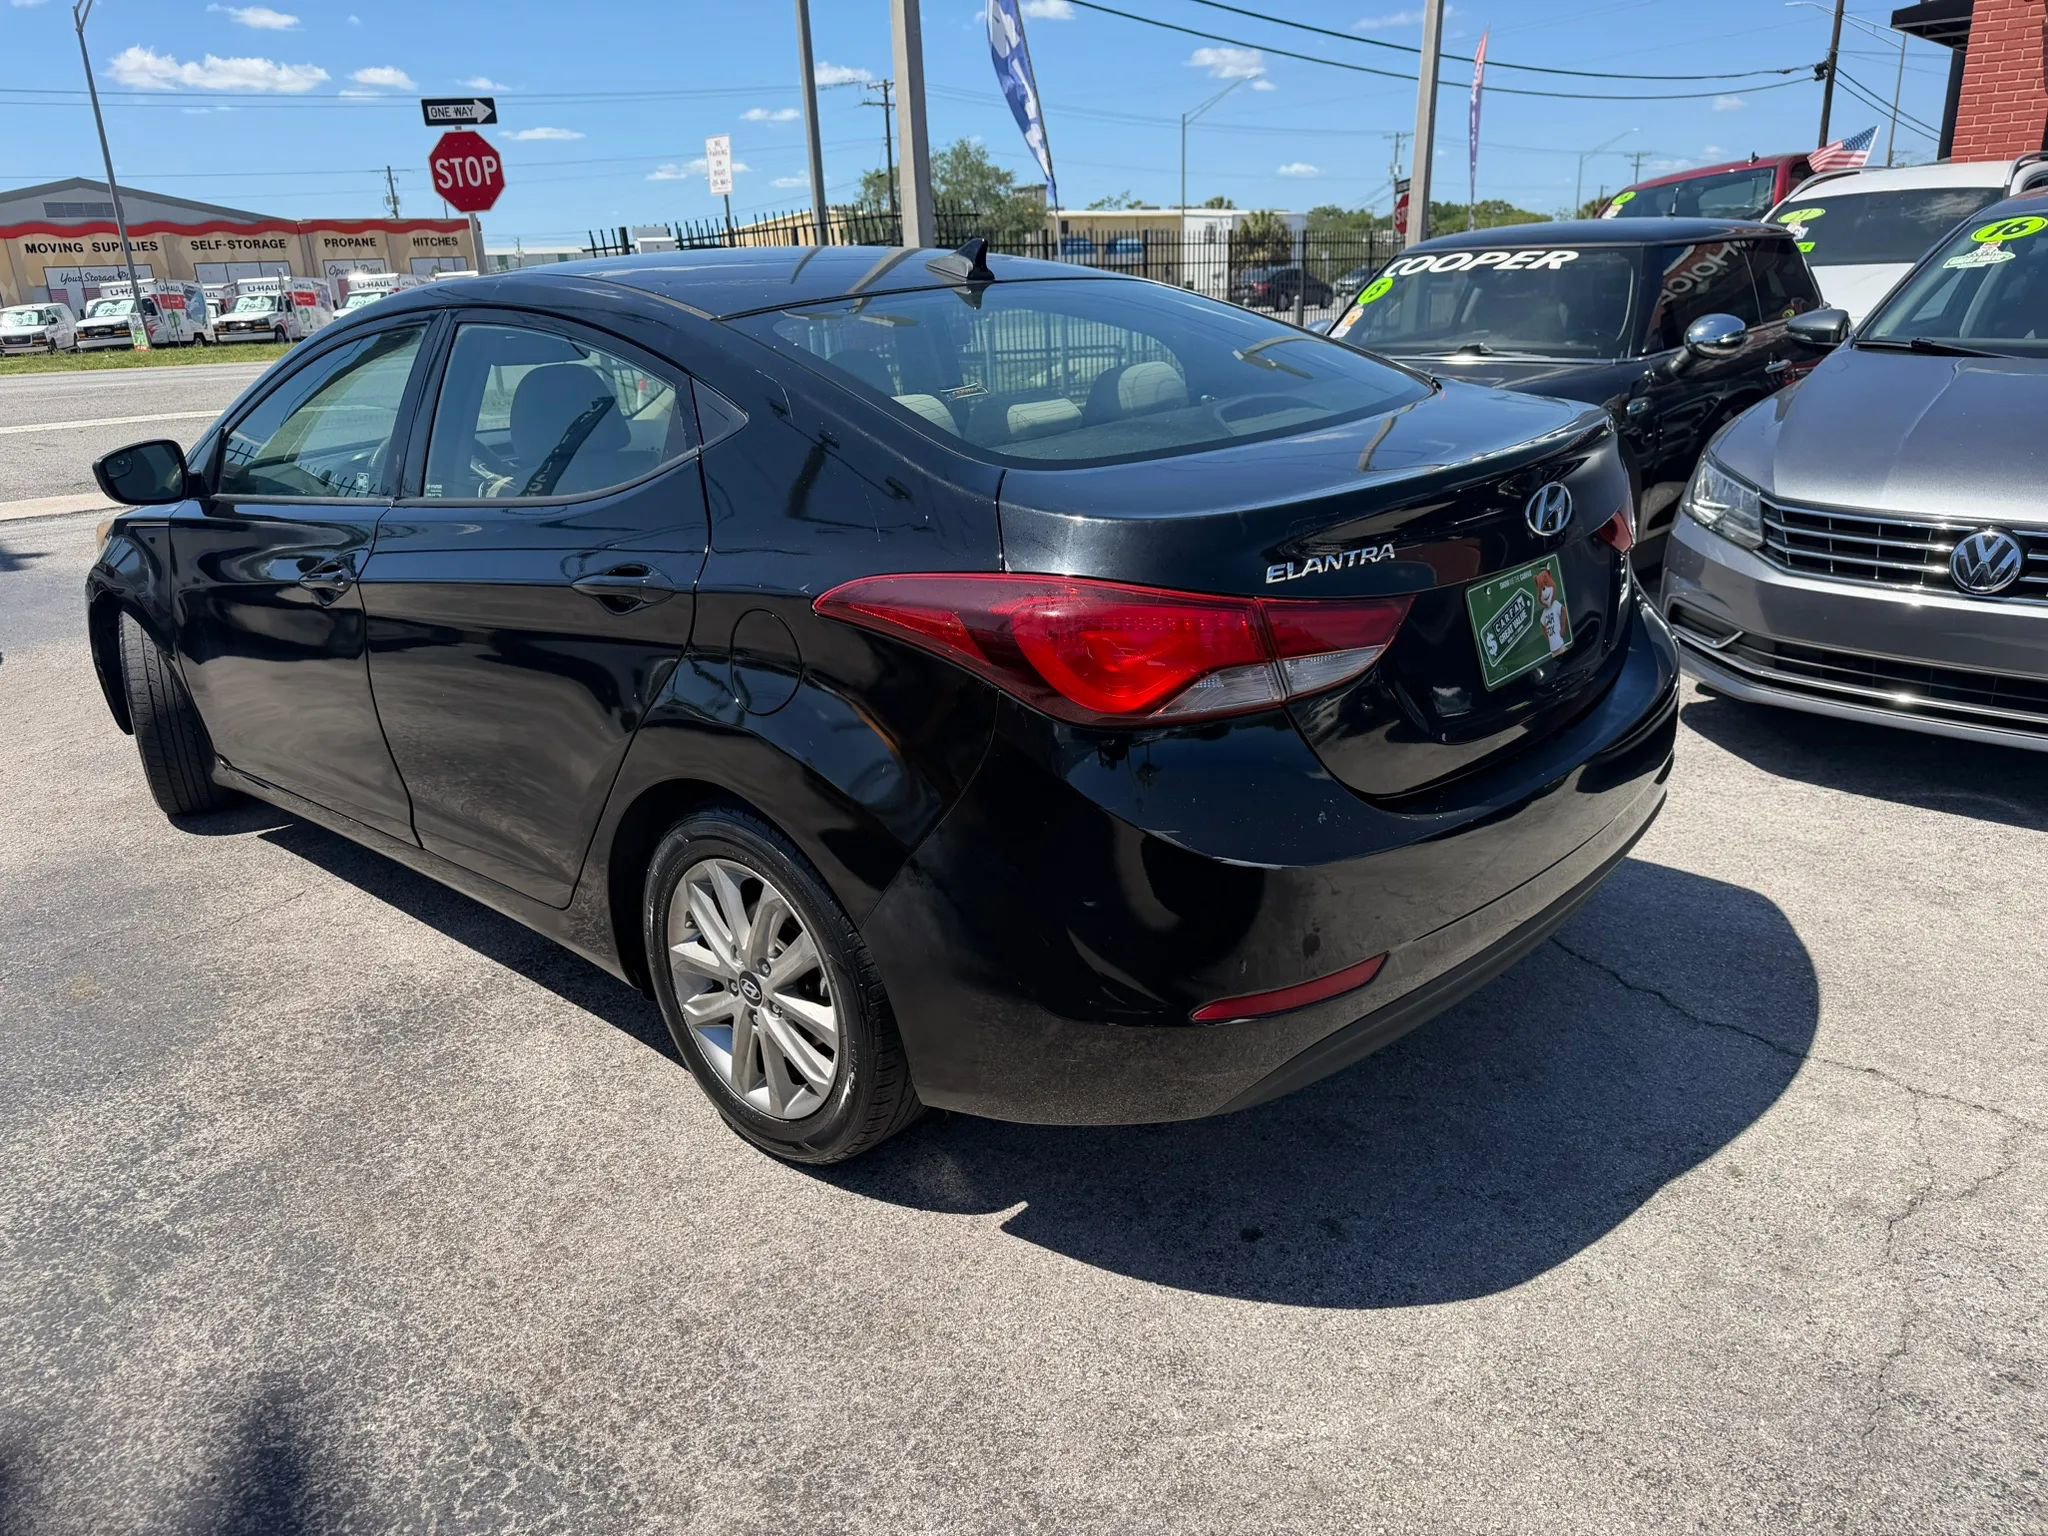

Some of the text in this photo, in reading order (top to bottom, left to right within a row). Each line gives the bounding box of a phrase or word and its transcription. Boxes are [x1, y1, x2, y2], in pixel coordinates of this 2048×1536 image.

[430, 106, 474, 118] ONE WAY
[435, 155, 498, 189] STOP
[1984, 219, 2034, 239] 16
[24, 242, 84, 254] MOVING
[190, 238, 287, 250] SELF-STORAGE
[324, 237, 377, 248] PROPANE
[413, 236, 458, 247] HITCHES
[1384, 250, 1580, 278] COOPER
[60, 272, 82, 286] Your
[84, 271, 115, 282] Storage
[357, 280, 392, 289] U-HAUL
[1265, 543, 1396, 584] ELANTRA
[1498, 625, 1515, 645] GREAT
[1512, 610, 1528, 628] VALUE
